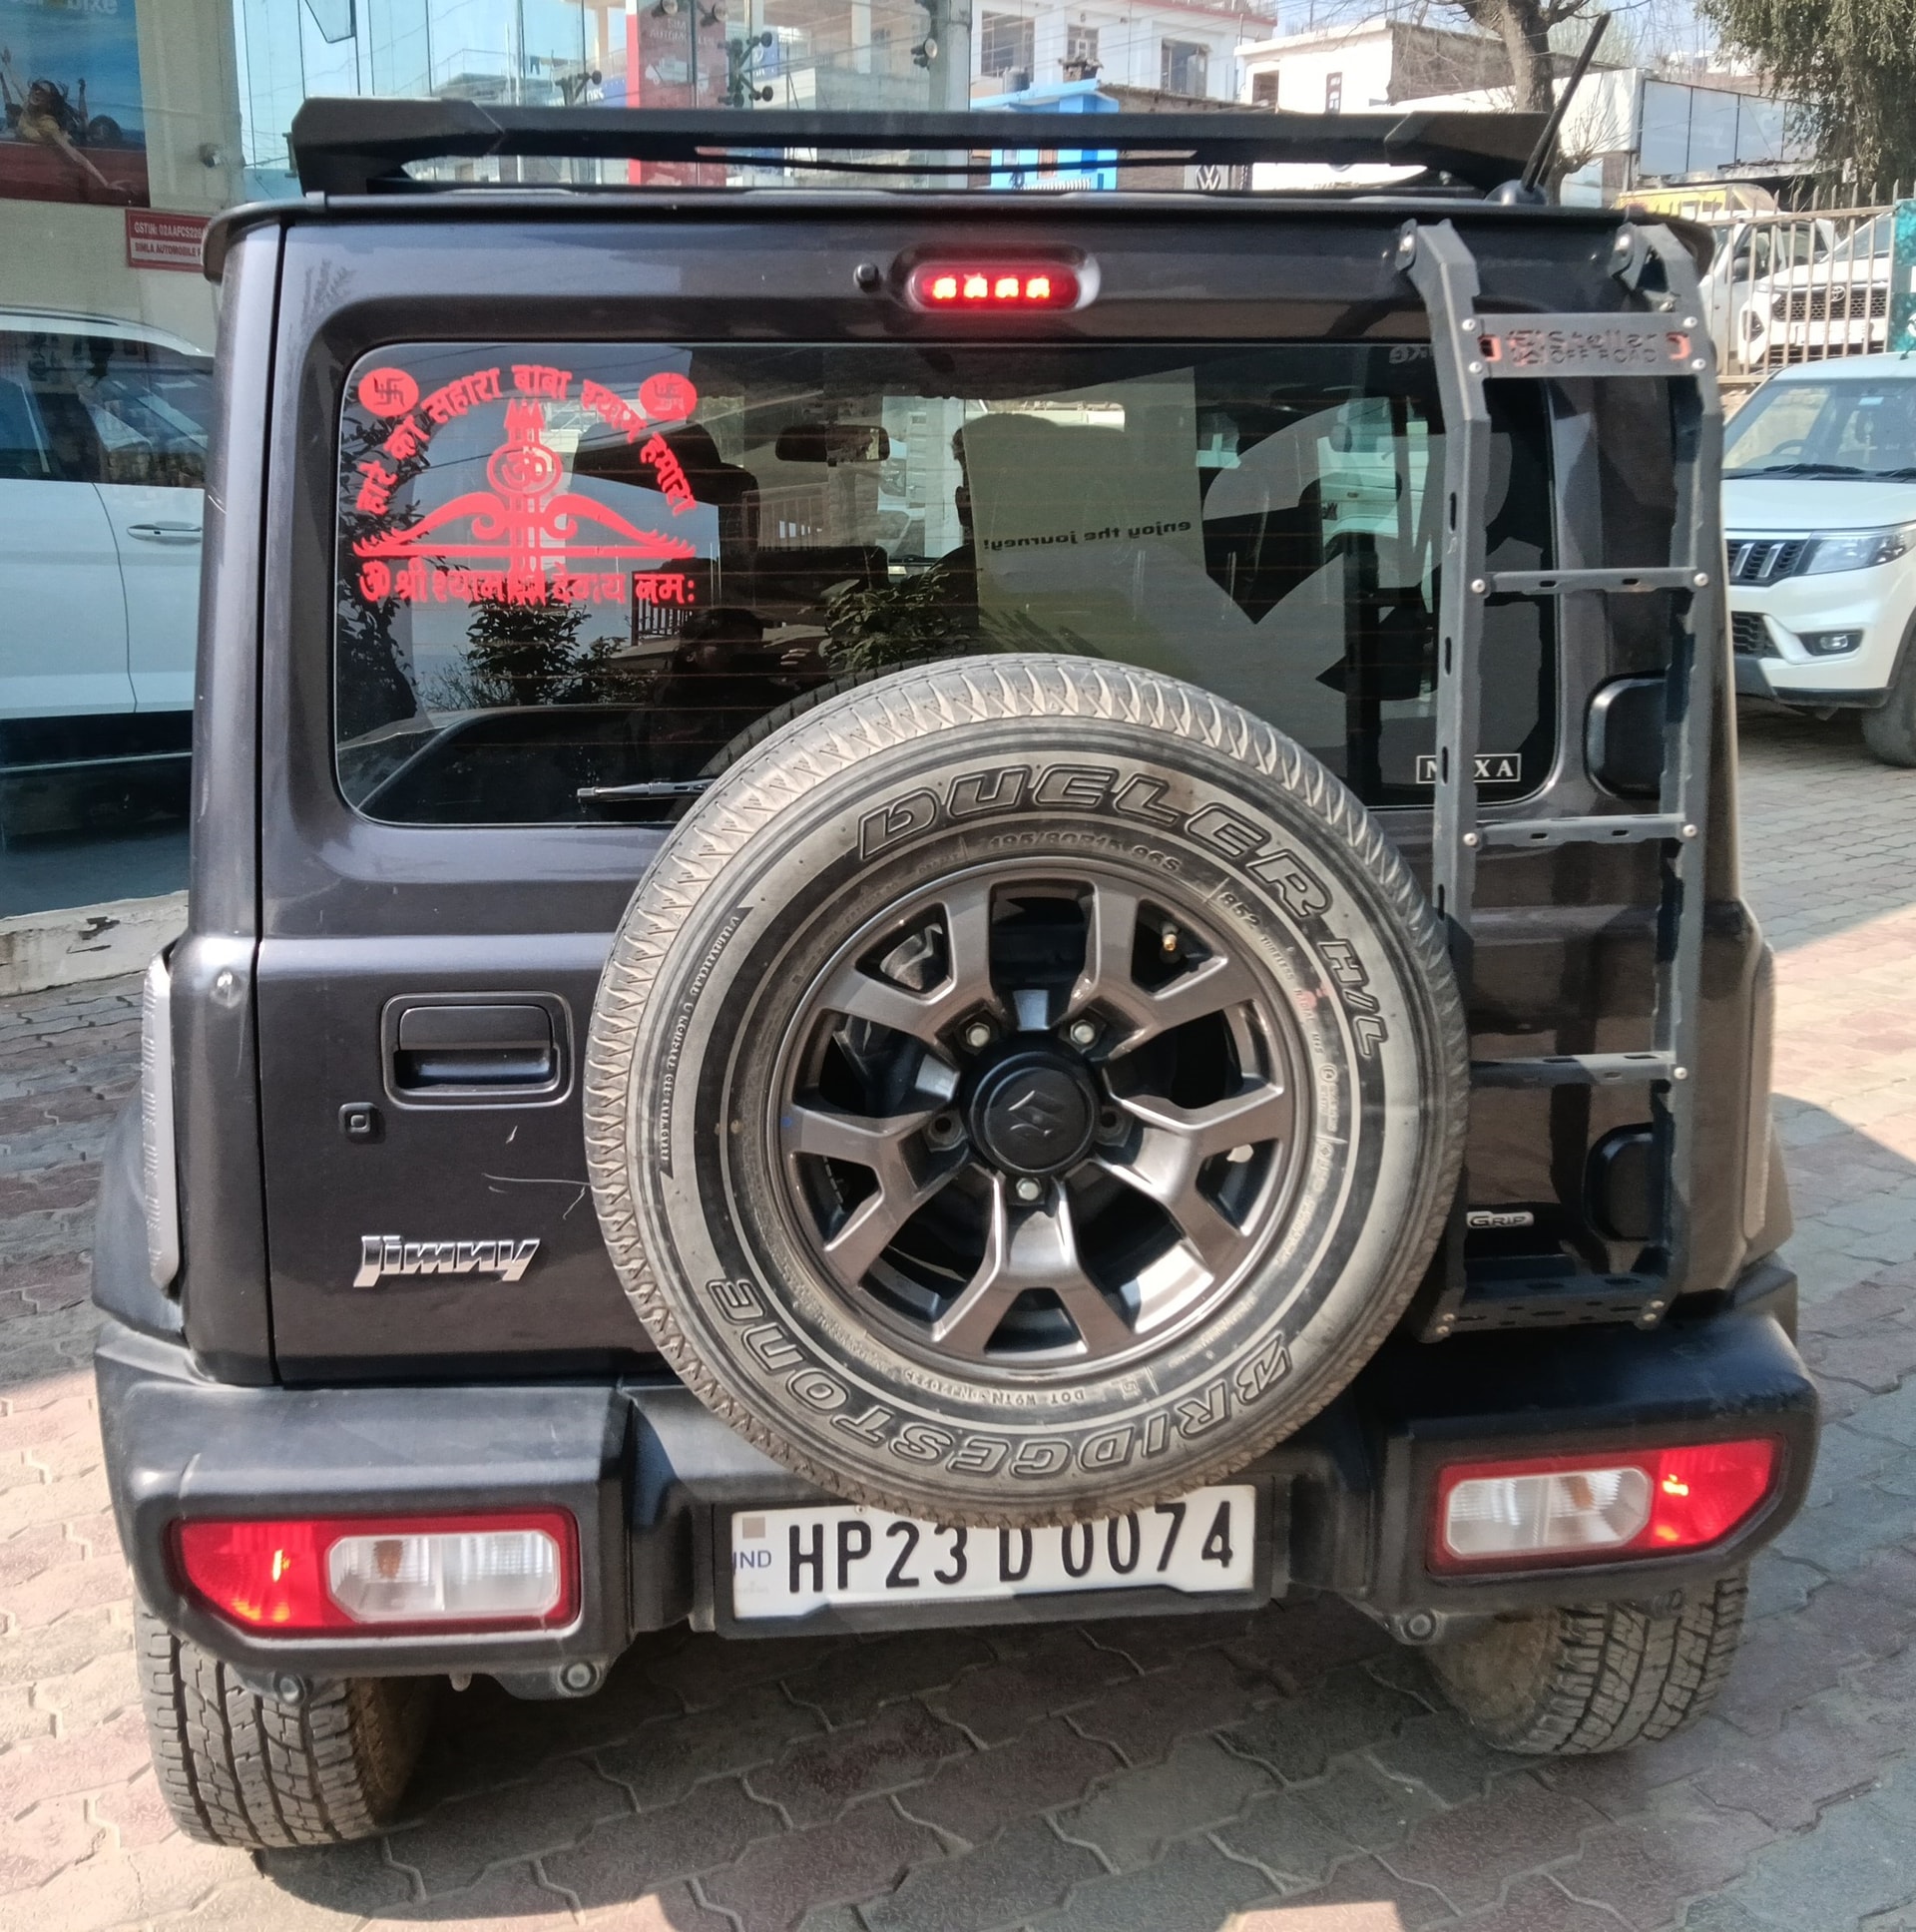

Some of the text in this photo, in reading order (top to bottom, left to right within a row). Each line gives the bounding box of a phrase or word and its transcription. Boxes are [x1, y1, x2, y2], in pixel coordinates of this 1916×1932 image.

[420, 367, 503, 423] सहारा
[511, 364, 573, 399] बाबा
[640, 432, 697, 517] हमारा
[859, 764, 1333, 919] DUELER
[1426, 759, 1514, 778] NXA
[708, 1278, 1294, 1479] BRIDGESTONE
[788, 1501, 1234, 1594] HP23 D 0074
